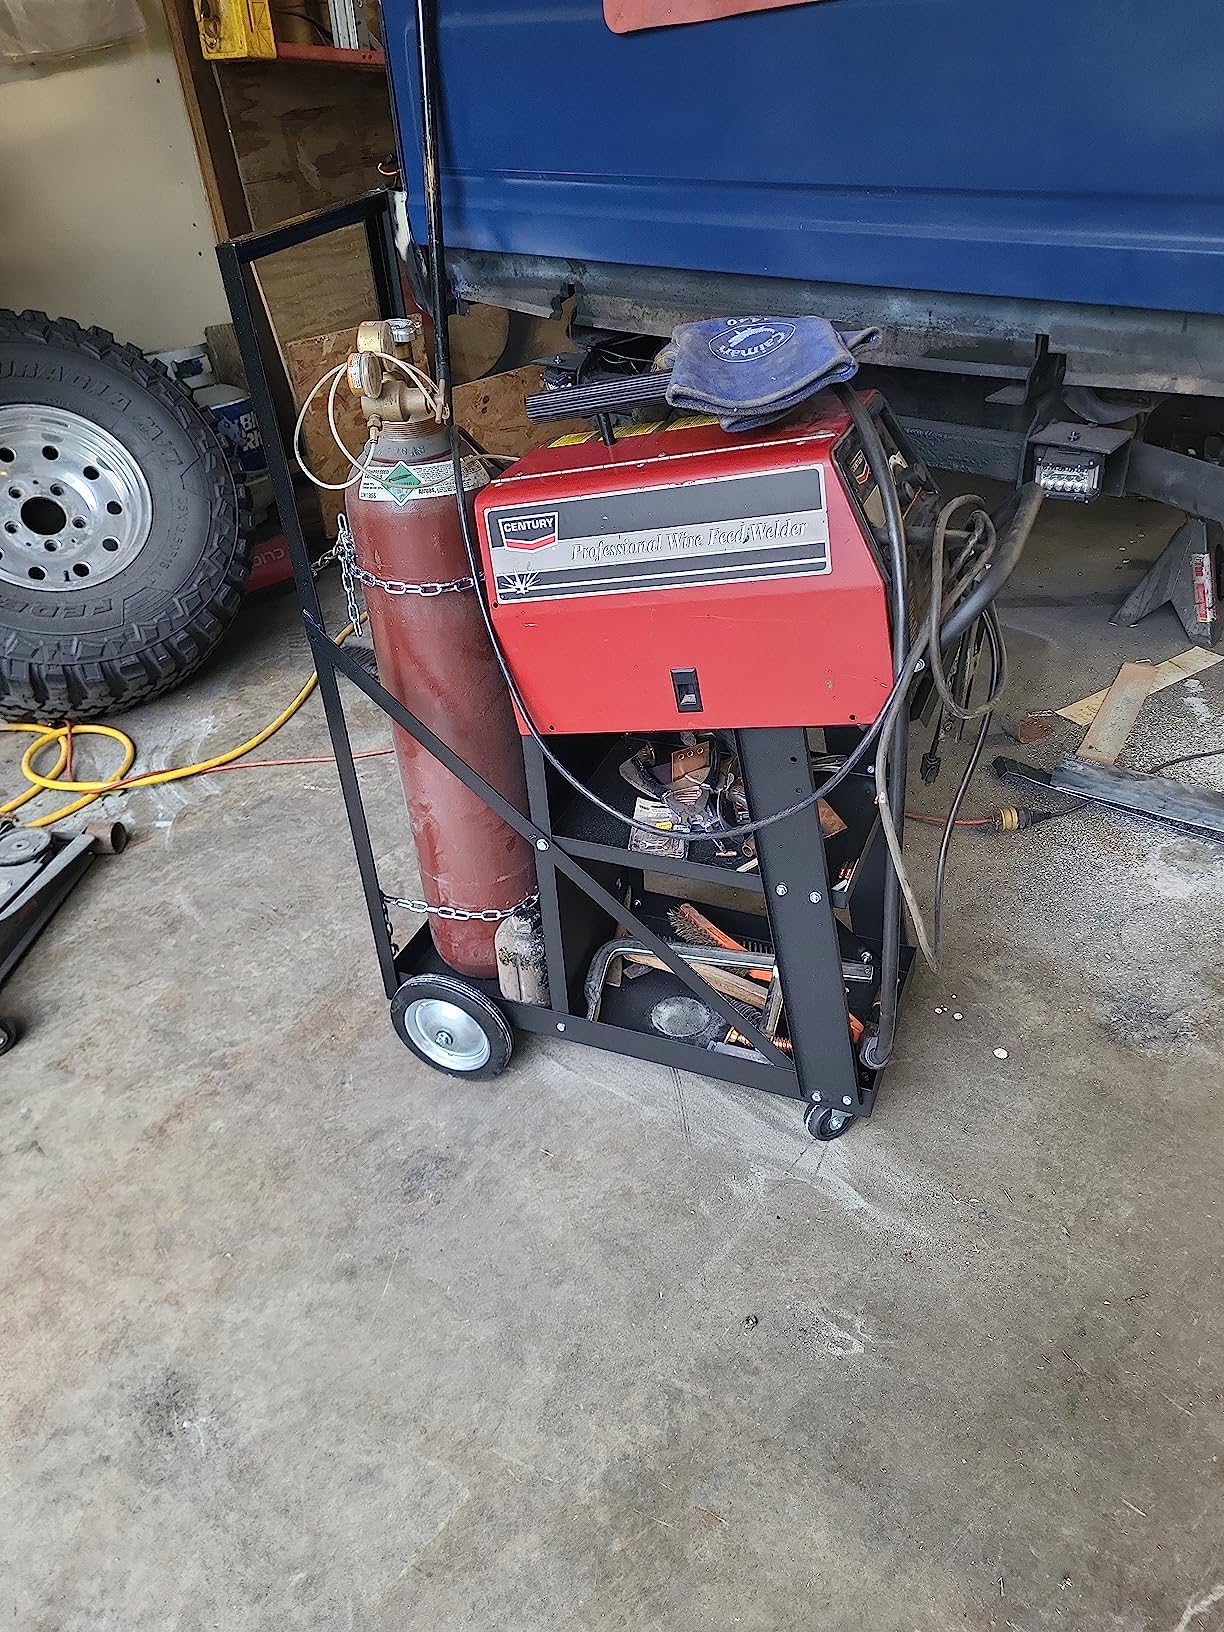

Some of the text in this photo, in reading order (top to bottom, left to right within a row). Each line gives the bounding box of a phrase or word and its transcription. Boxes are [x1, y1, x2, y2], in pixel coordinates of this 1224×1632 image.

[716, 331, 786, 357] Caiman
[503, 517, 554, 533] CENTURY
[571, 518, 808, 561] Professional Wire Feed Welder
